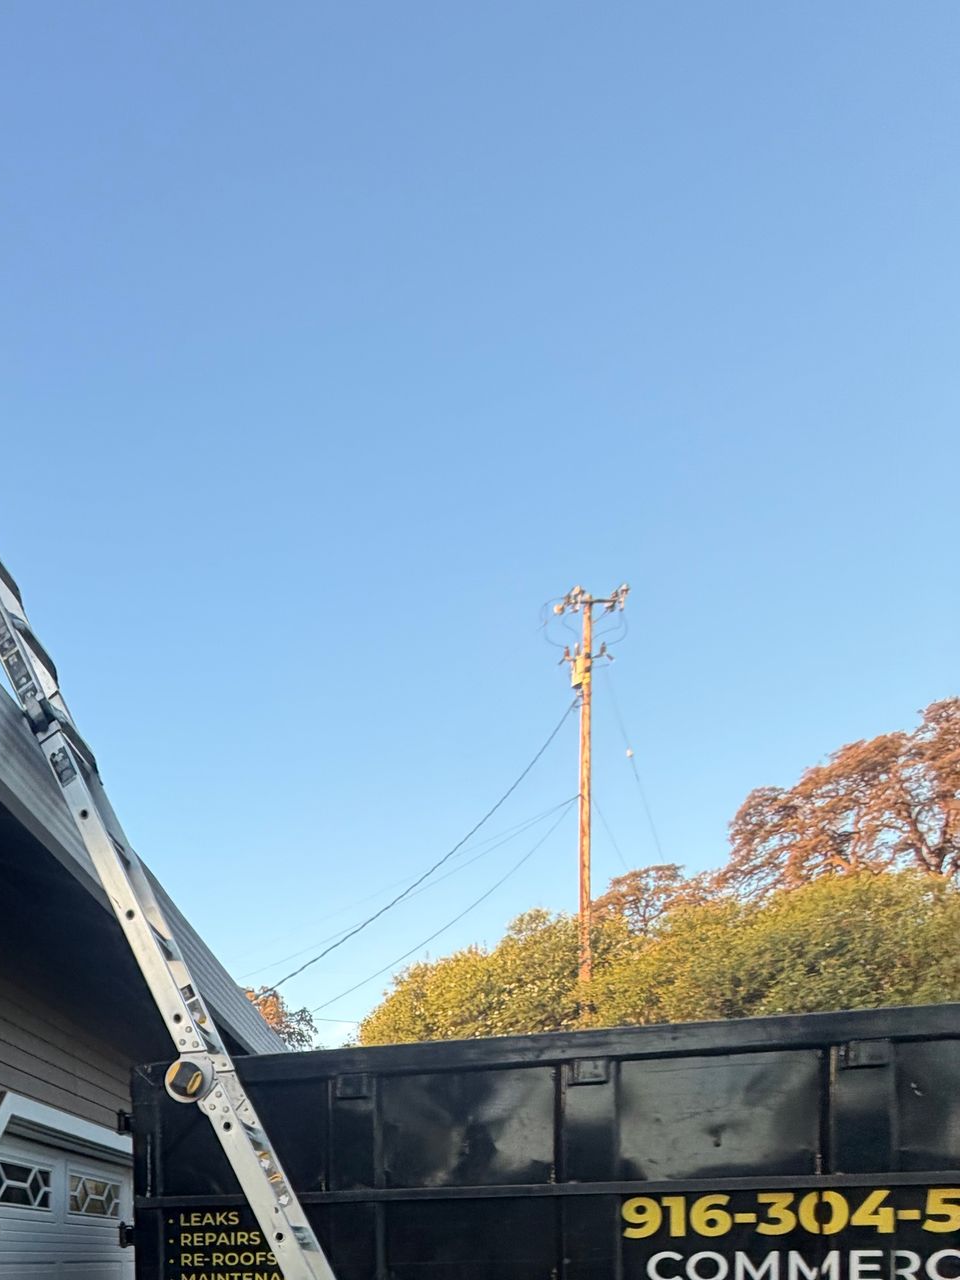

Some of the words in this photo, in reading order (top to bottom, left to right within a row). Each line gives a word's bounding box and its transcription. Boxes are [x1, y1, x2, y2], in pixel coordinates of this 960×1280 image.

[179, 1211, 240, 1227] LEAKS
[621, 1189, 960, 1239] 916-304-5
[179, 1231, 261, 1247] REPAIRS
[180, 1251, 278, 1267] RE-ROOFS
